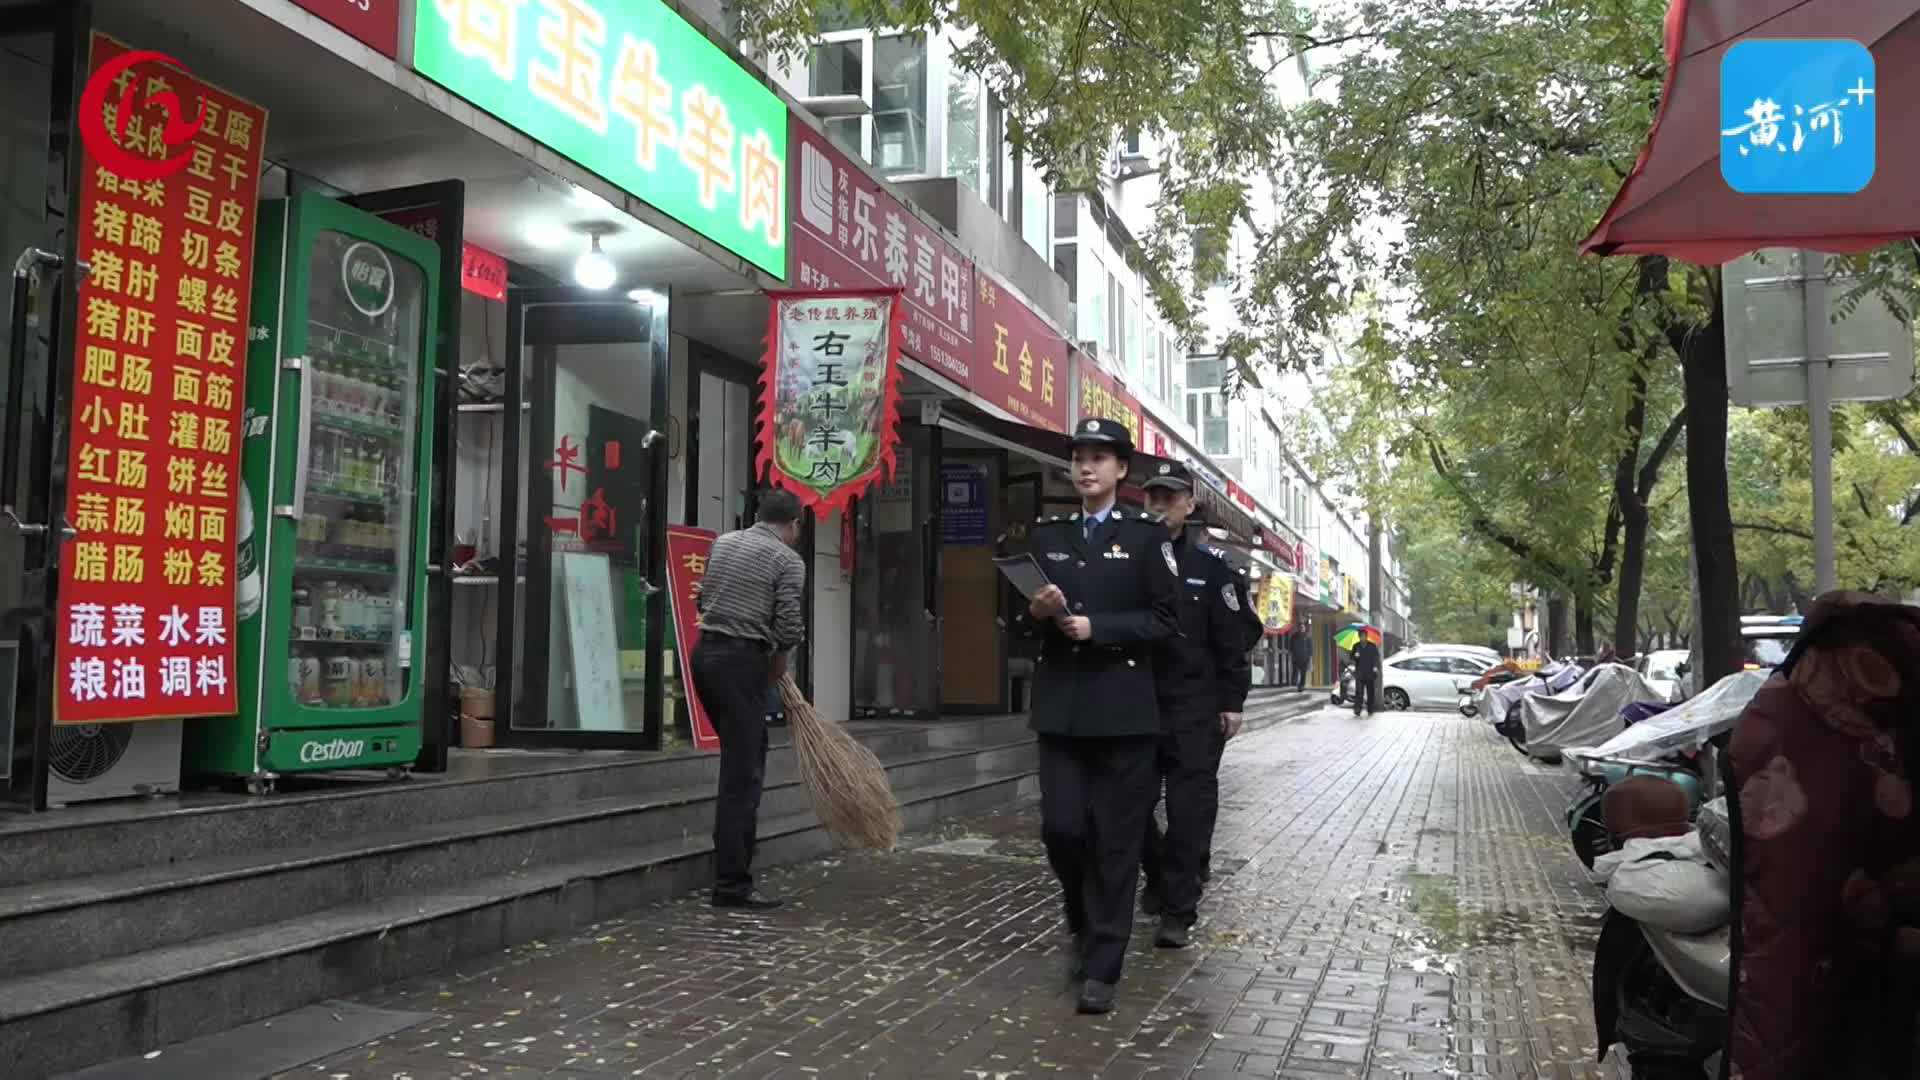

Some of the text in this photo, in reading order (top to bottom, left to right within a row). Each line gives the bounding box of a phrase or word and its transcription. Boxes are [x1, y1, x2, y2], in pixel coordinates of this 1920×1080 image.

[197, 95, 254, 151] 豆腐
[187, 140, 249, 192] 豆干
[93, 199, 163, 256] 猪蹄
[183, 184, 244, 238] 豆皮
[90, 248, 159, 304] 猪肘
[180, 229, 242, 281] 切条
[852, 186, 960, 321] 乐泰亮甲
[86, 297, 156, 348] 猪肝
[177, 274, 239, 325] 螺丝
[176, 319, 236, 368] 面皮
[993, 320, 1055, 409] 五金店
[82, 346, 153, 396] 肥肠
[172, 364, 234, 412] 面筋
[80, 394, 150, 441] 小肚
[807, 330, 851, 484] 右玉牛羊肉
[168, 411, 231, 455] 灌肠
[77, 442, 147, 490] 红肠
[166, 455, 229, 498] 饼丝
[75, 492, 146, 537] 蒜肠
[164, 501, 228, 543] 焖面
[73, 542, 145, 584] 腊肠
[163, 547, 226, 587] 粉条
[69, 602, 228, 648] 蔬菜 水果
[69, 655, 228, 702] 粮油 调料
